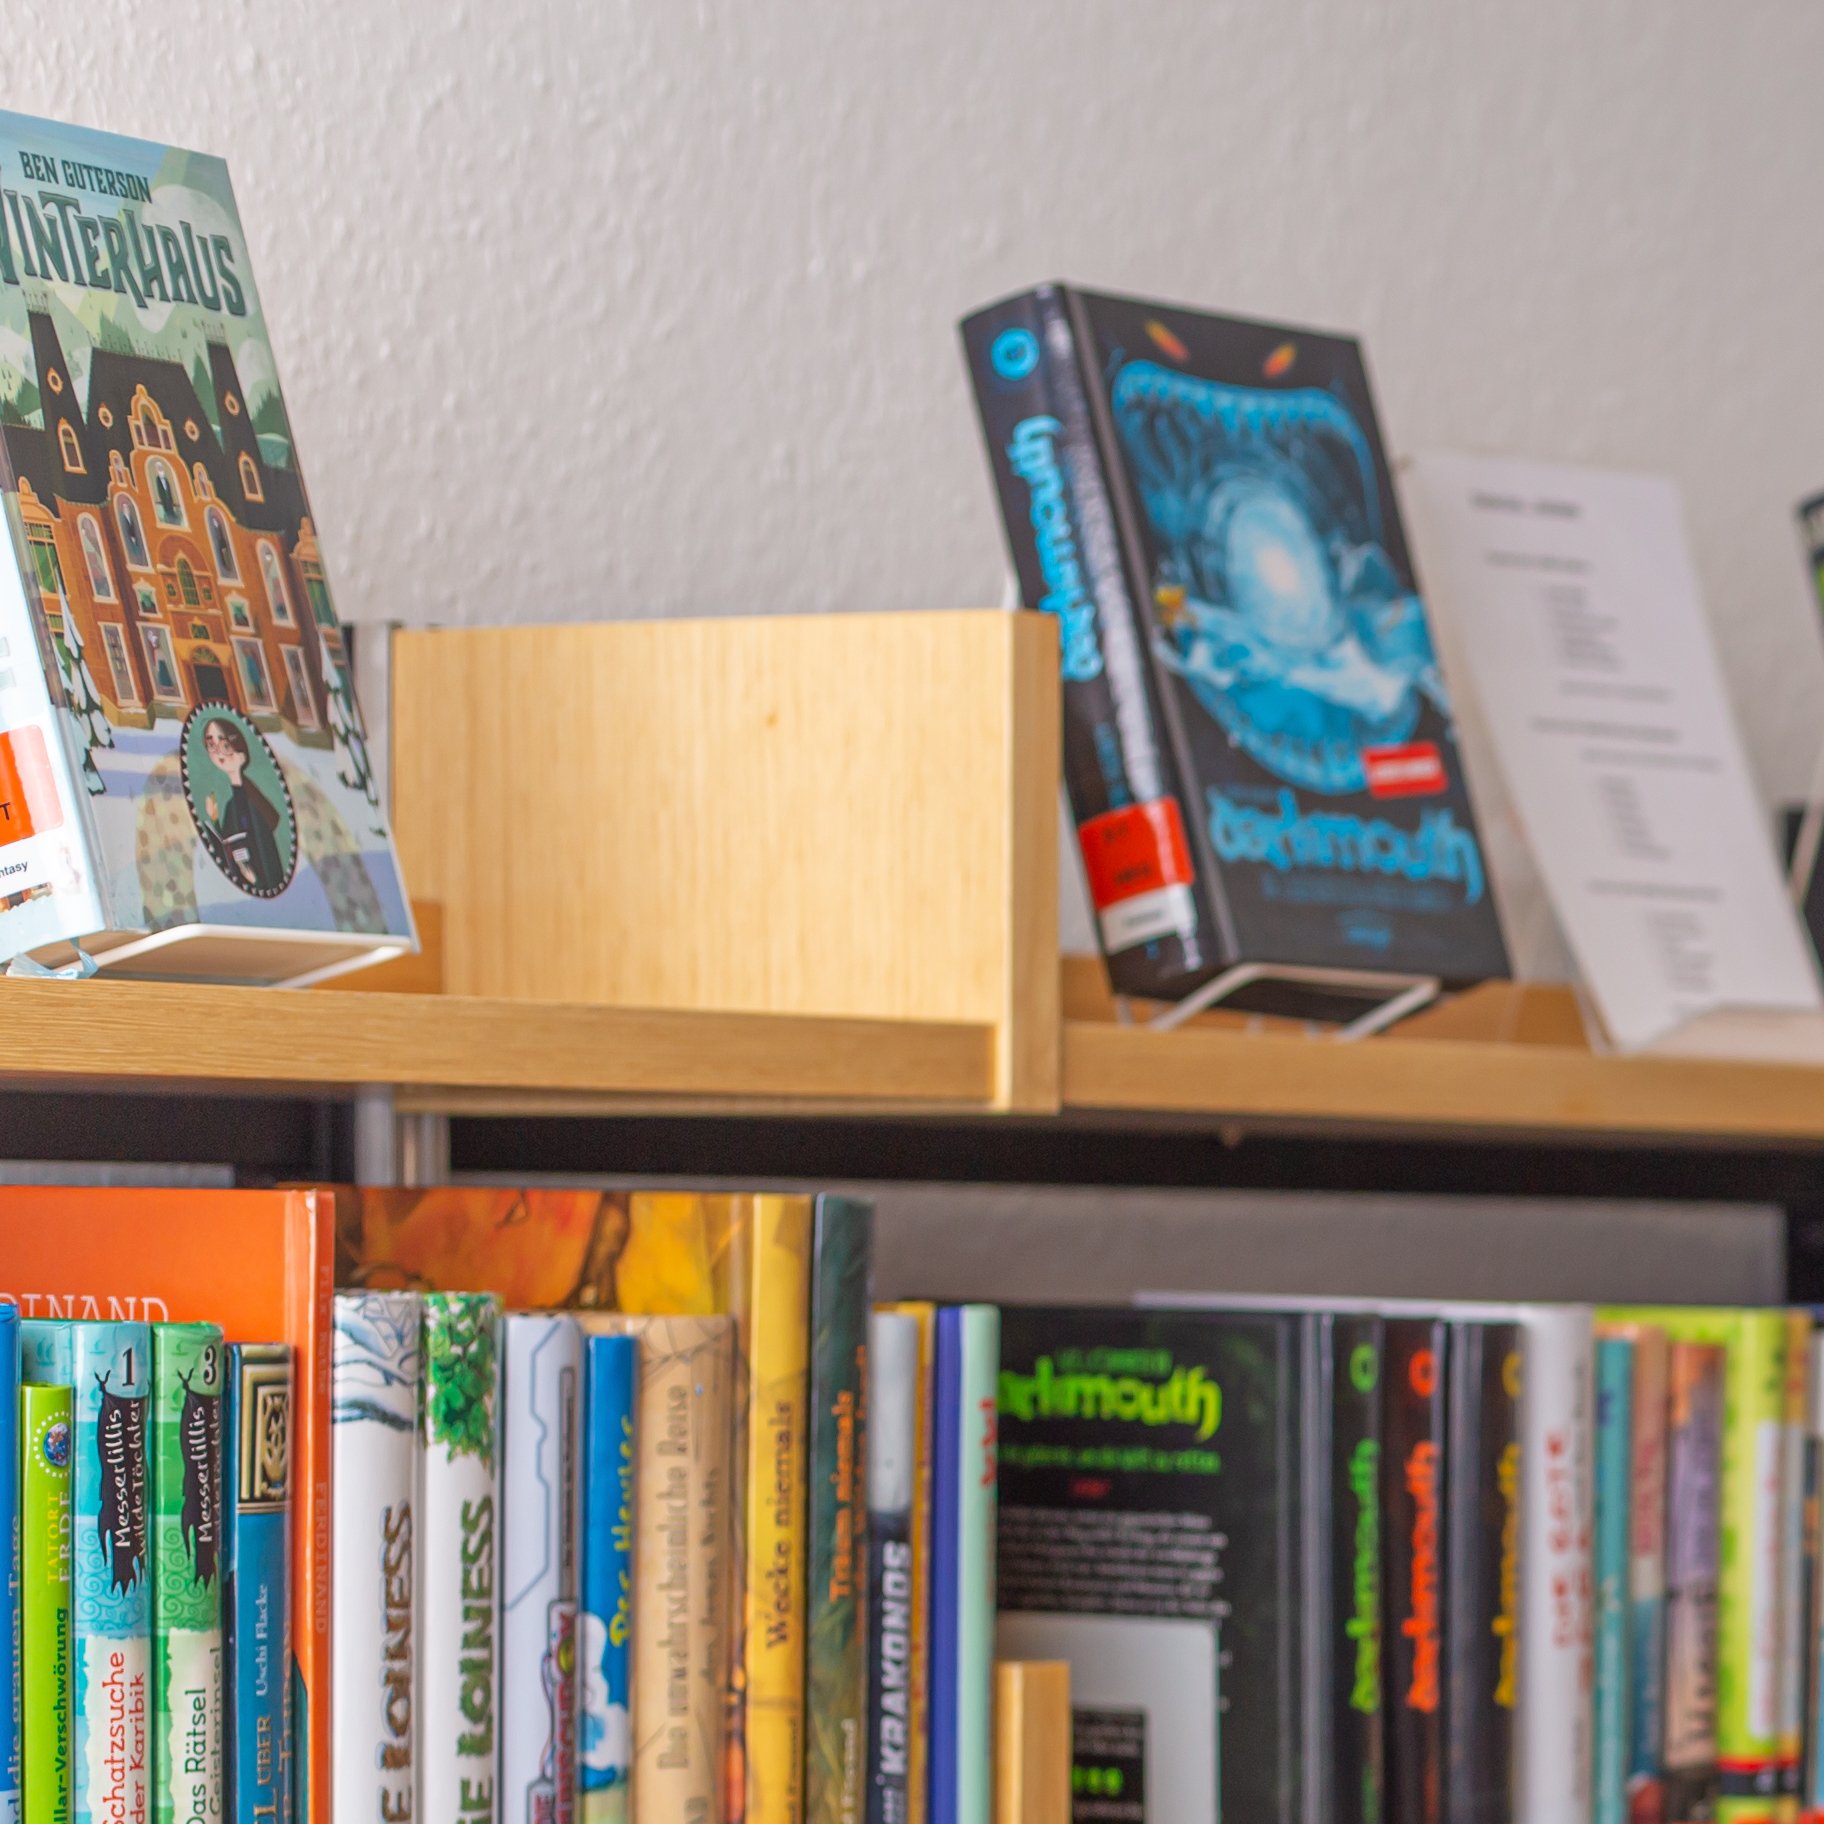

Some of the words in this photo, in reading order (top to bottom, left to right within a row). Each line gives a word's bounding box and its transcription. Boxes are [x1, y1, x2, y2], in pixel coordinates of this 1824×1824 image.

[19, 150, 60, 185] BEN
[61, 159, 153, 204] GUTERSON
[122, 1346, 136, 1388] 1
[202, 1344, 217, 1386] 3
[104, 1408, 131, 1548] Messerlillis
[189, 1405, 214, 1544] Messerlillis
[48, 1490, 59, 1584] TATORT
[59, 1489, 71, 1584] ERDE
[315, 1481, 327, 1634] FERDINAND
[253, 1583, 271, 1640] Flacke
[880, 1540, 910, 1776] KRAKONOS
[254, 1645, 271, 1697] Uschi
[128, 1671, 147, 1771] Karibik
[183, 1688, 208, 1774] Rätsel
